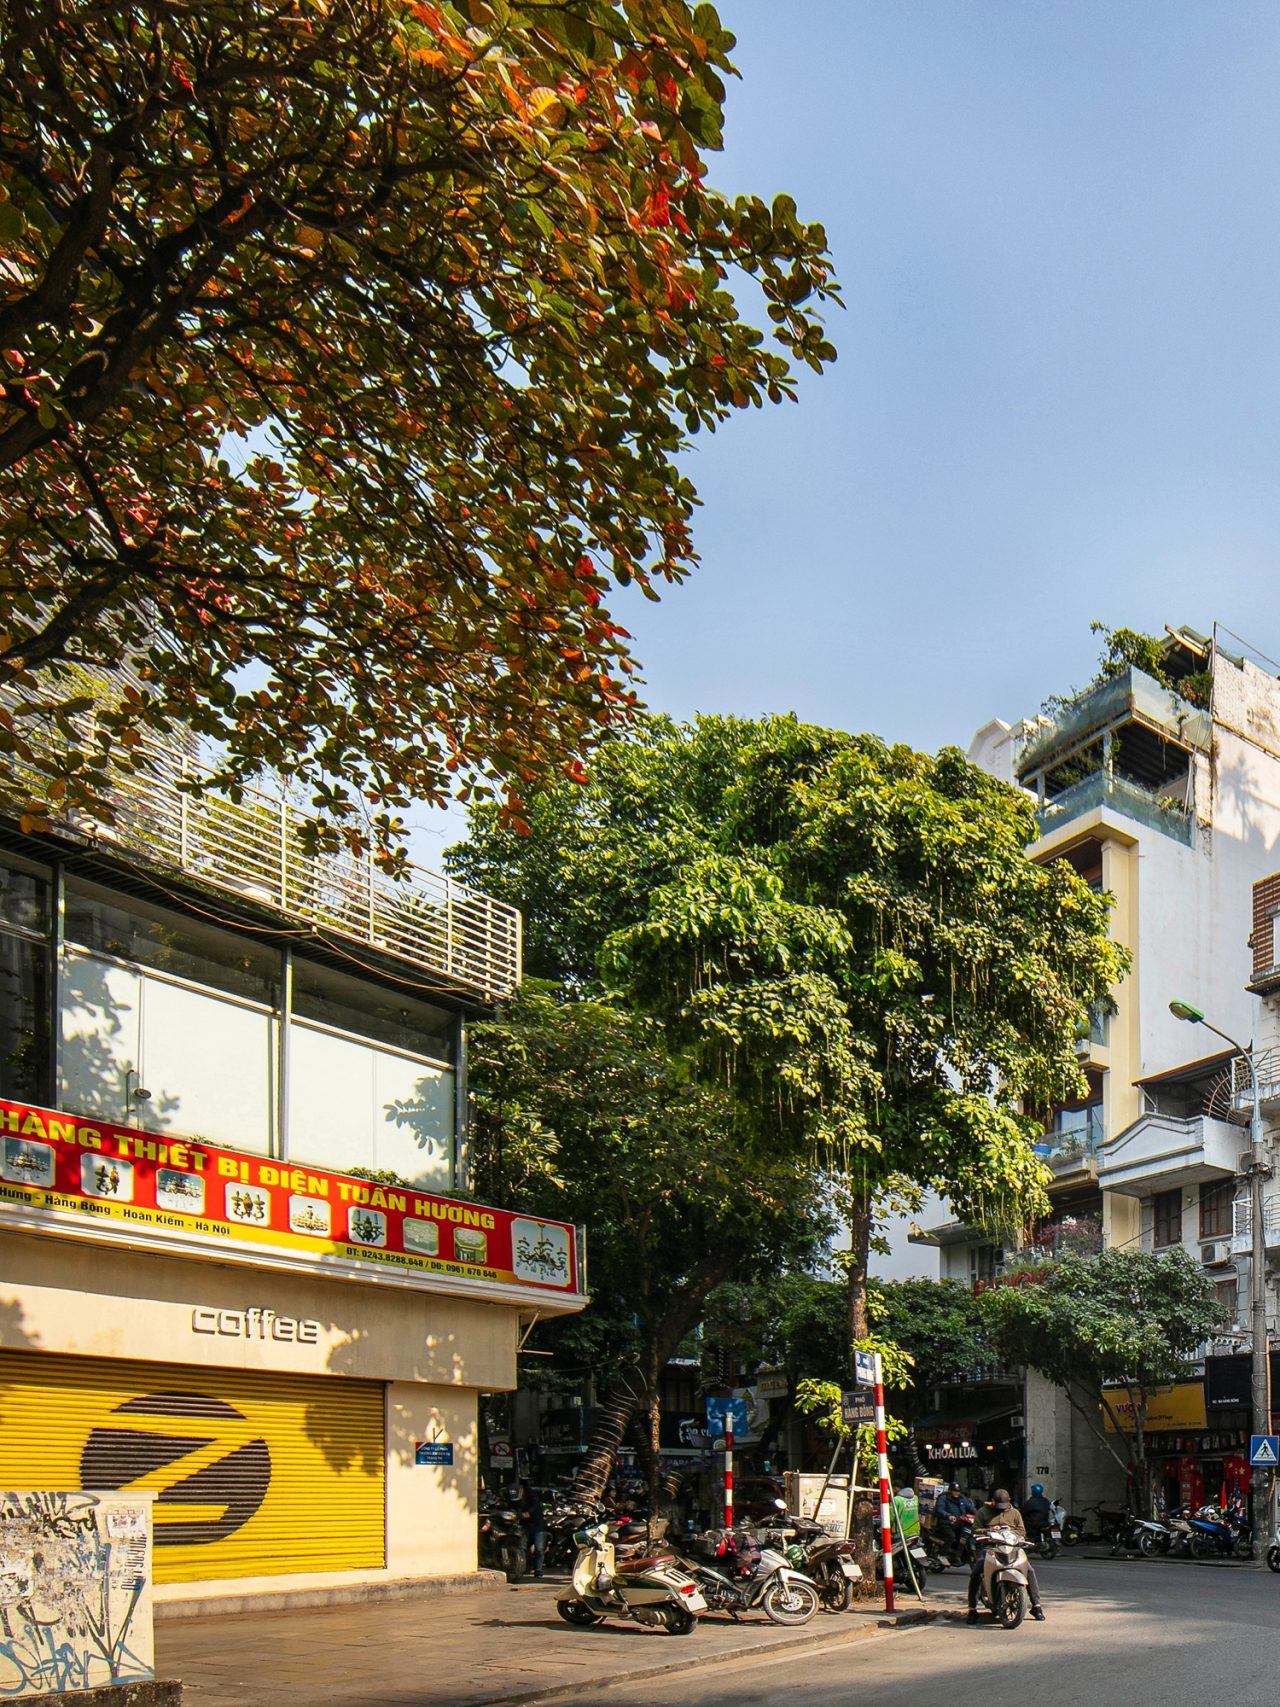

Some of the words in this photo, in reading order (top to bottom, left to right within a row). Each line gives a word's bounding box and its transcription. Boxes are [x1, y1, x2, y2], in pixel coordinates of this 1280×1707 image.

[0, 1109, 102, 1150] HÀNG
[114, 1134, 208, 1171] THIẾT
[218, 1156, 249, 1184] BỊ
[258, 1166, 329, 1197] ĐIỆN
[337, 1182, 407, 1212] TUẤN
[415, 1199, 496, 1230] HƯƠNG
[45, 1195, 77, 1211] Hàng
[80, 1200, 111, 1216] Bông
[123, 1208, 152, 1222] Hoàn
[156, 1214, 184, 1227] Kiếm
[195, 1221, 209, 1232] Hà
[212, 1224, 230, 1236] Nội
[346, 1247, 360, 1257] ĐT:
[192, 1307, 322, 1344] coffee
